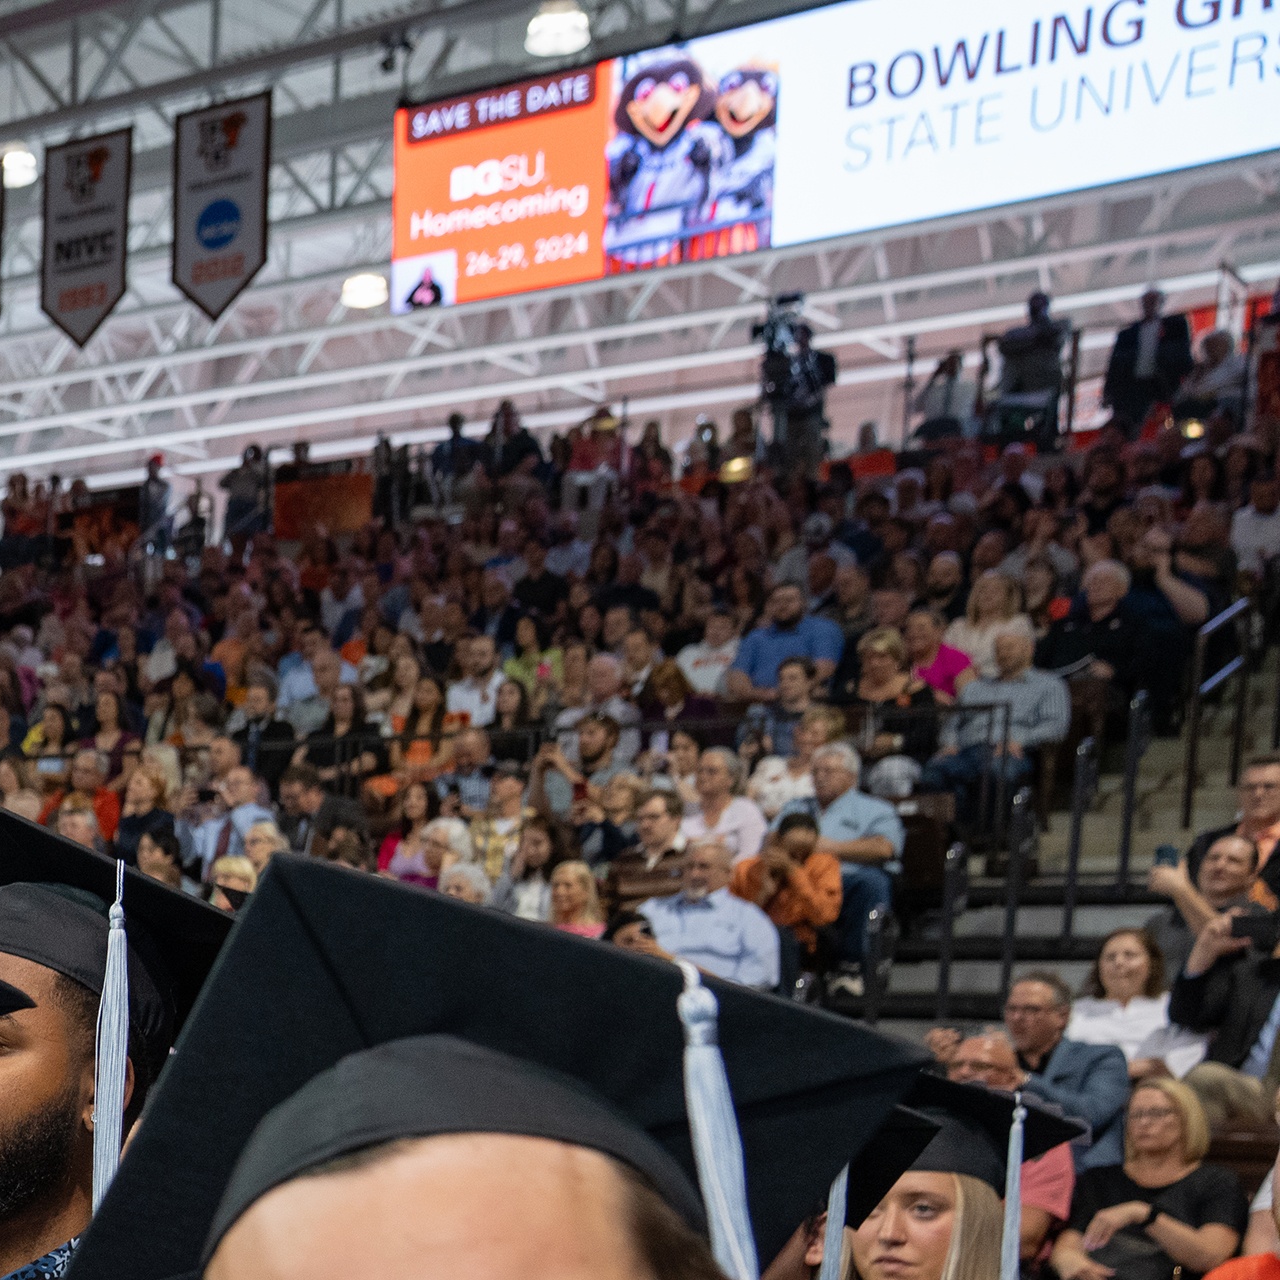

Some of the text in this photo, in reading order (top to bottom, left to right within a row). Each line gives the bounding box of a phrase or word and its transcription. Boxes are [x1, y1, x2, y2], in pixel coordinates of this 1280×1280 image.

[845, 0, 1280, 110] BOWLING G
[412, 73, 590, 139] SAVE THE DATE
[842, 30, 1280, 173] STATE UNIVER
[449, 150, 546, 203] BGSU
[410, 184, 590, 241] Homecoming
[534, 230, 589, 264] 2024
